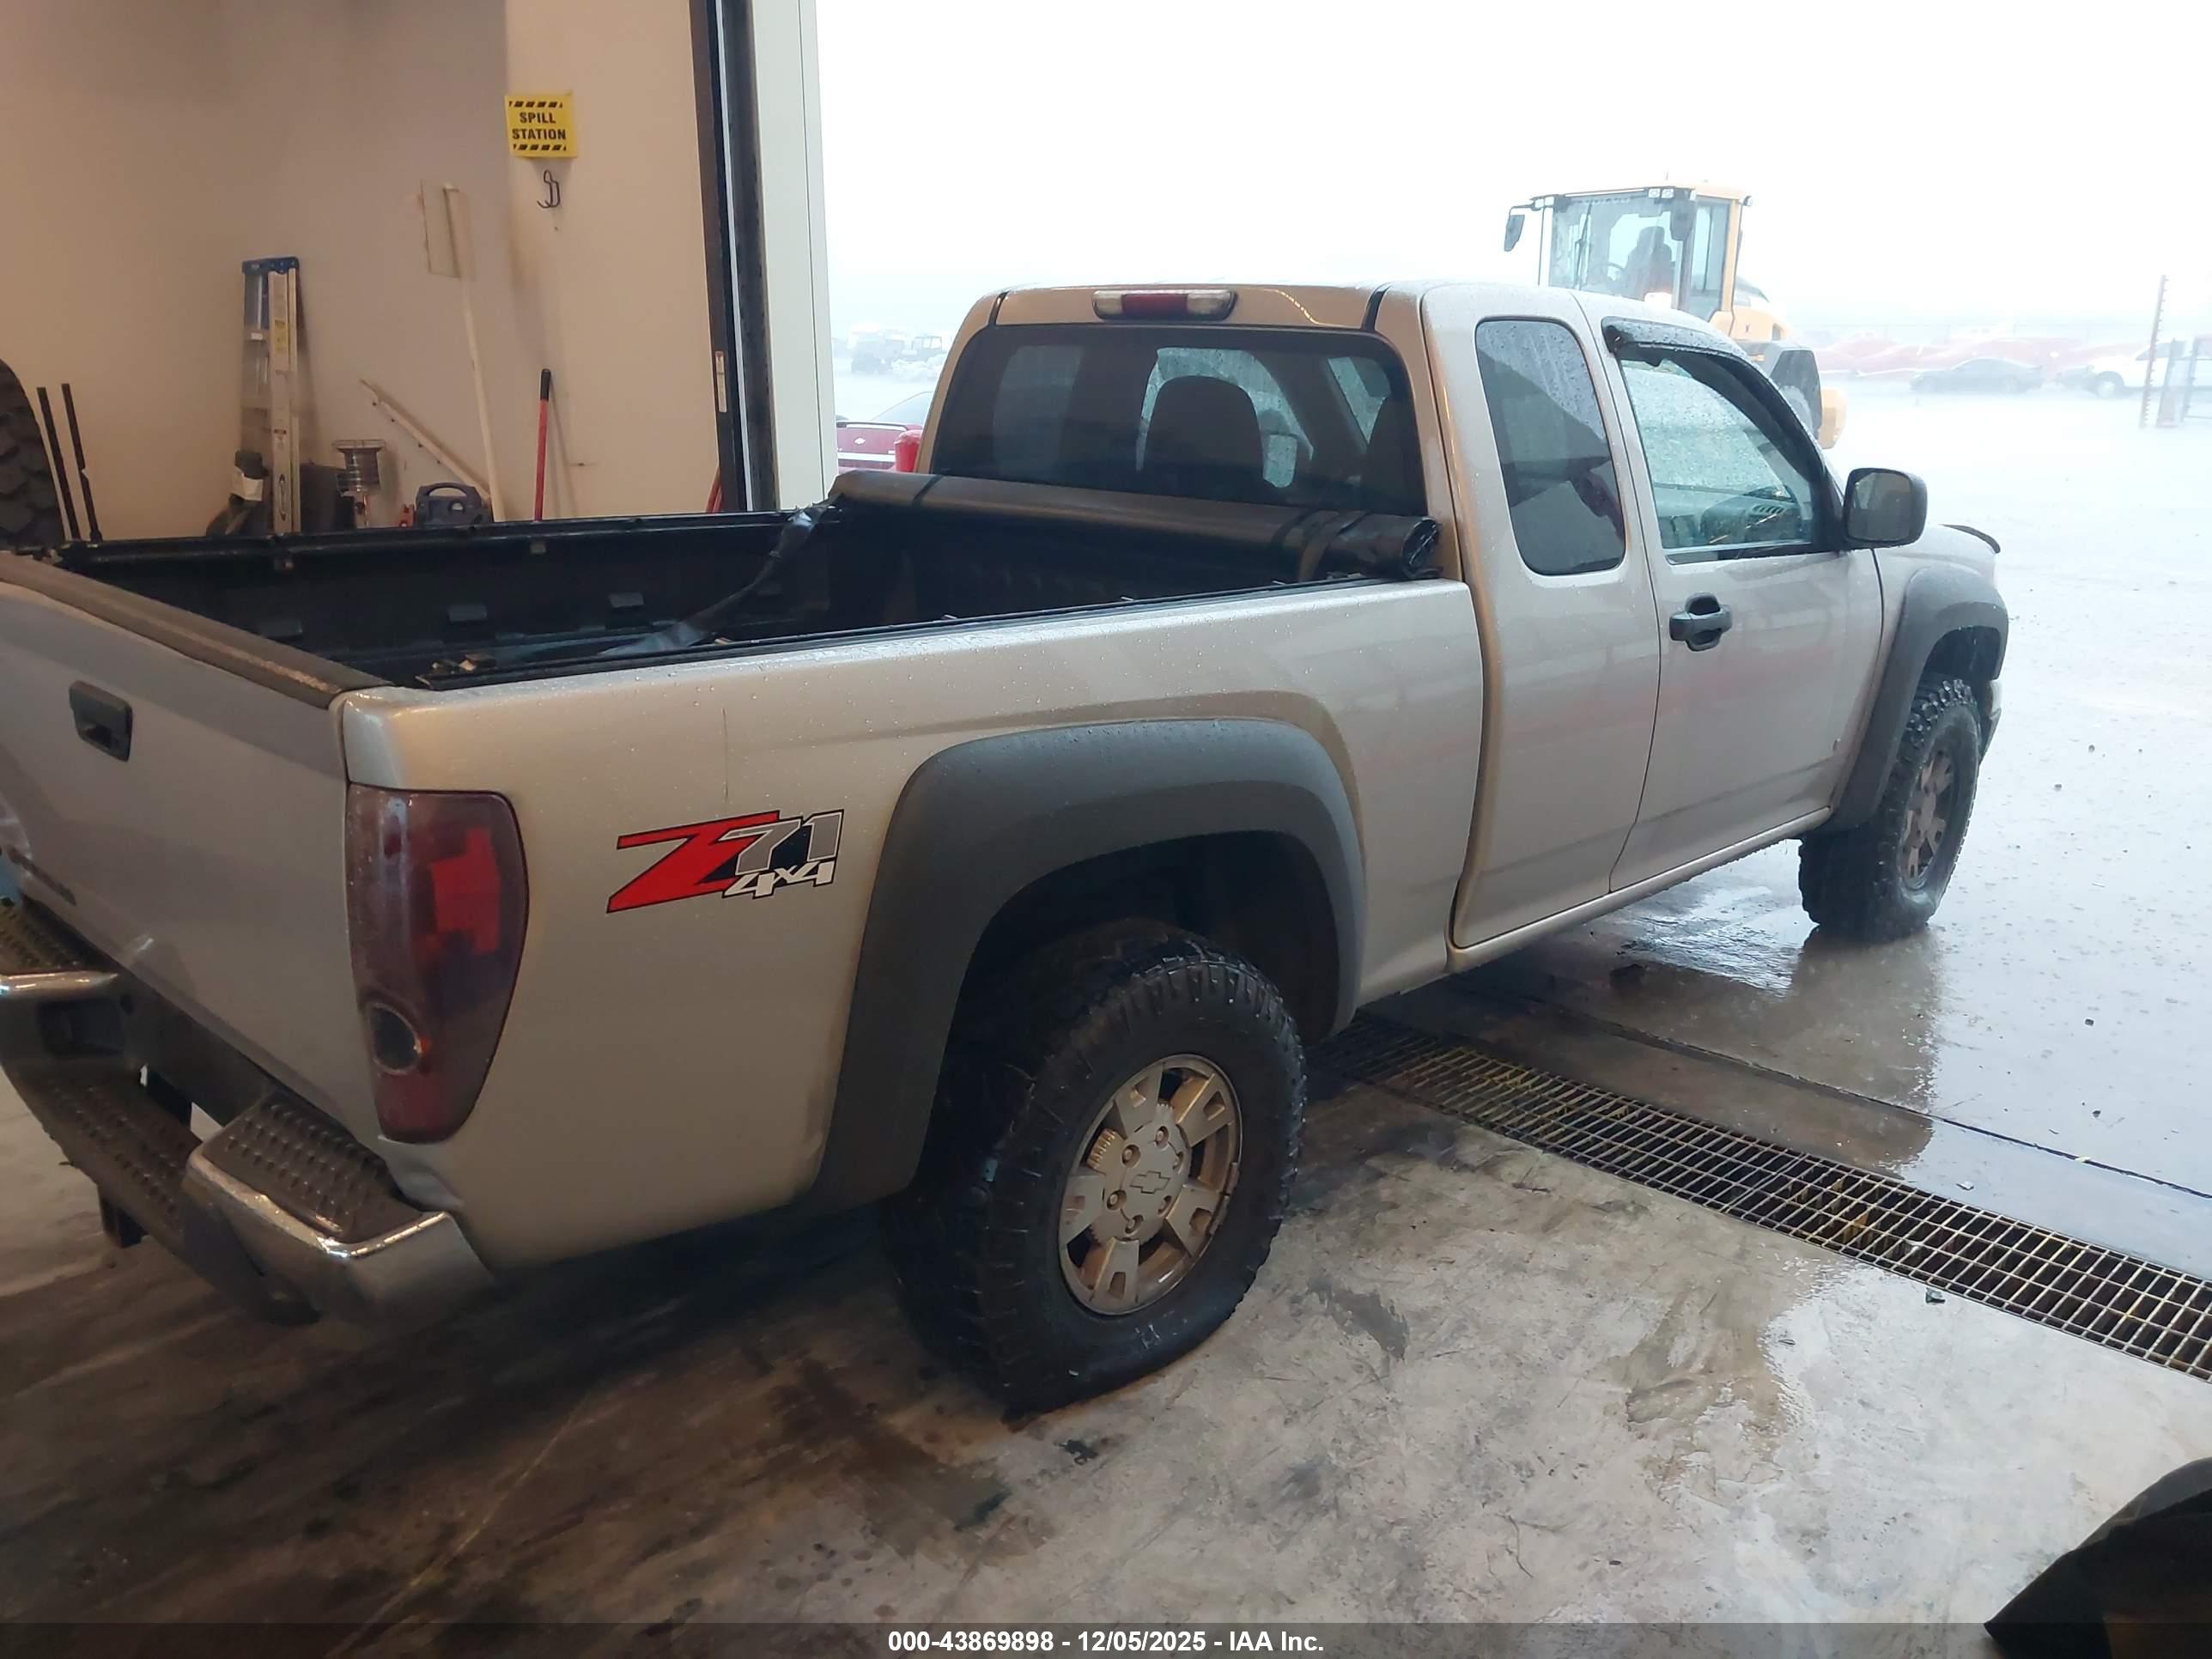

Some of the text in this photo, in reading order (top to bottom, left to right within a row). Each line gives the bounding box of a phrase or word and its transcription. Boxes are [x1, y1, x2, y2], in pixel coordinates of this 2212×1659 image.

[520, 112, 556, 124] SPILL
[512, 128, 567, 140] STATION
[606, 809, 844, 914] Z71
